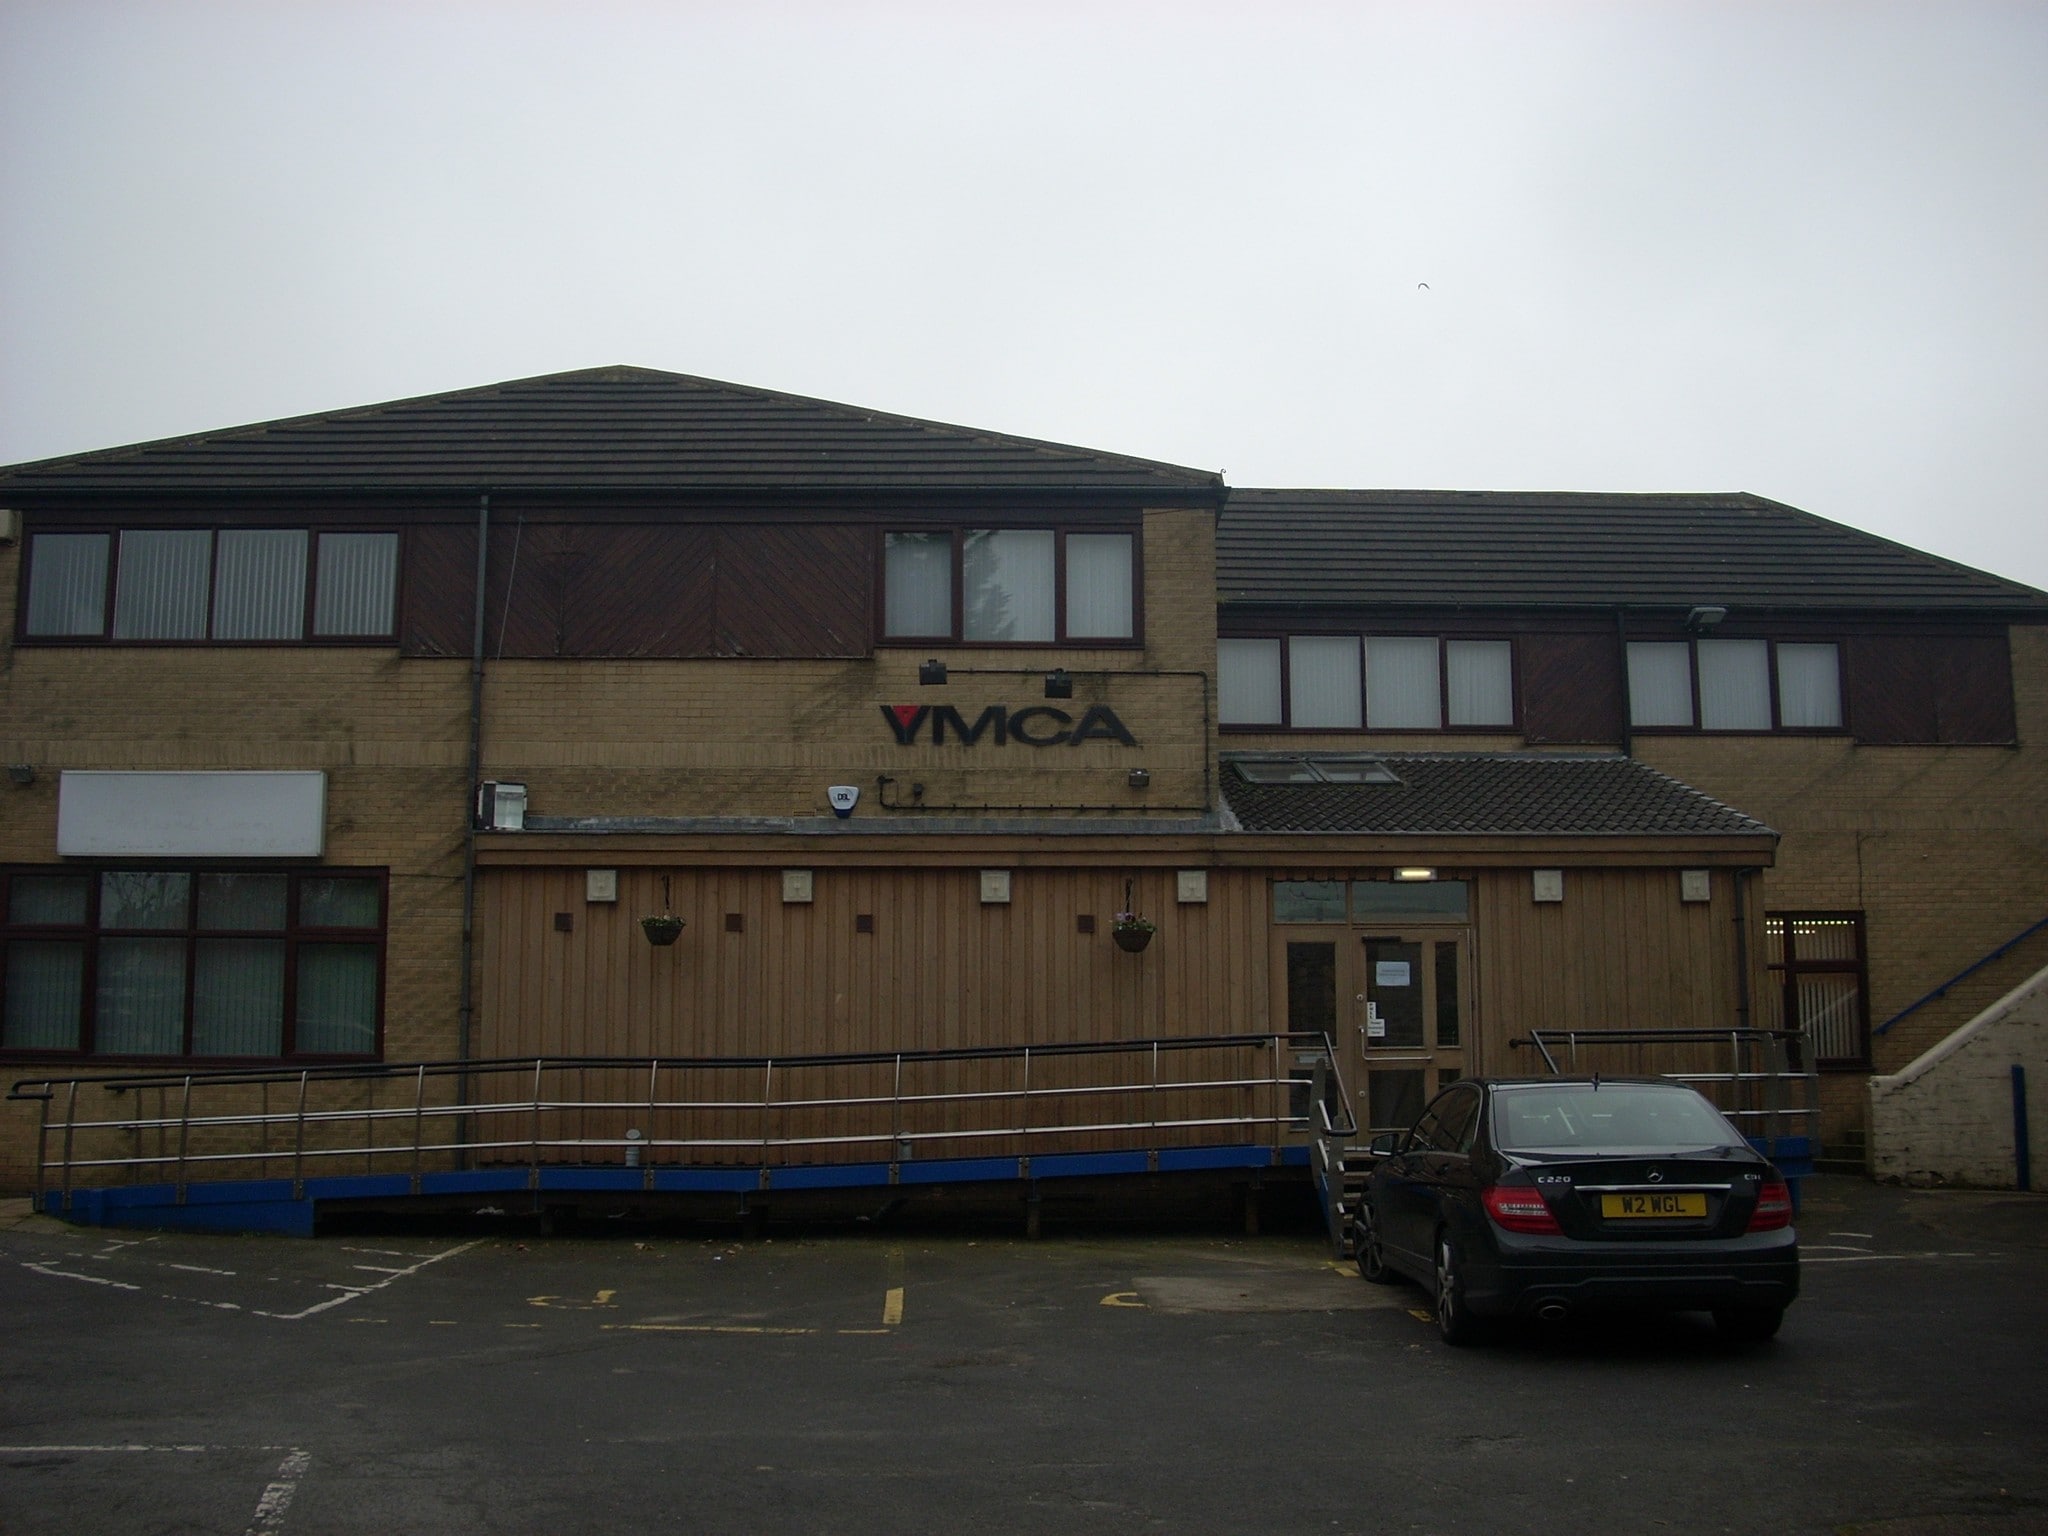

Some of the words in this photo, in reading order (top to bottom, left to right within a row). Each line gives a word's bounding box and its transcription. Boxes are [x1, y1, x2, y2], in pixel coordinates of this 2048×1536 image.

[879, 705, 1138, 747] YMCA
[1546, 1175, 1572, 1184] 220
[1622, 1195, 1646, 1214] W2
[1650, 1195, 1687, 1213] WGL
